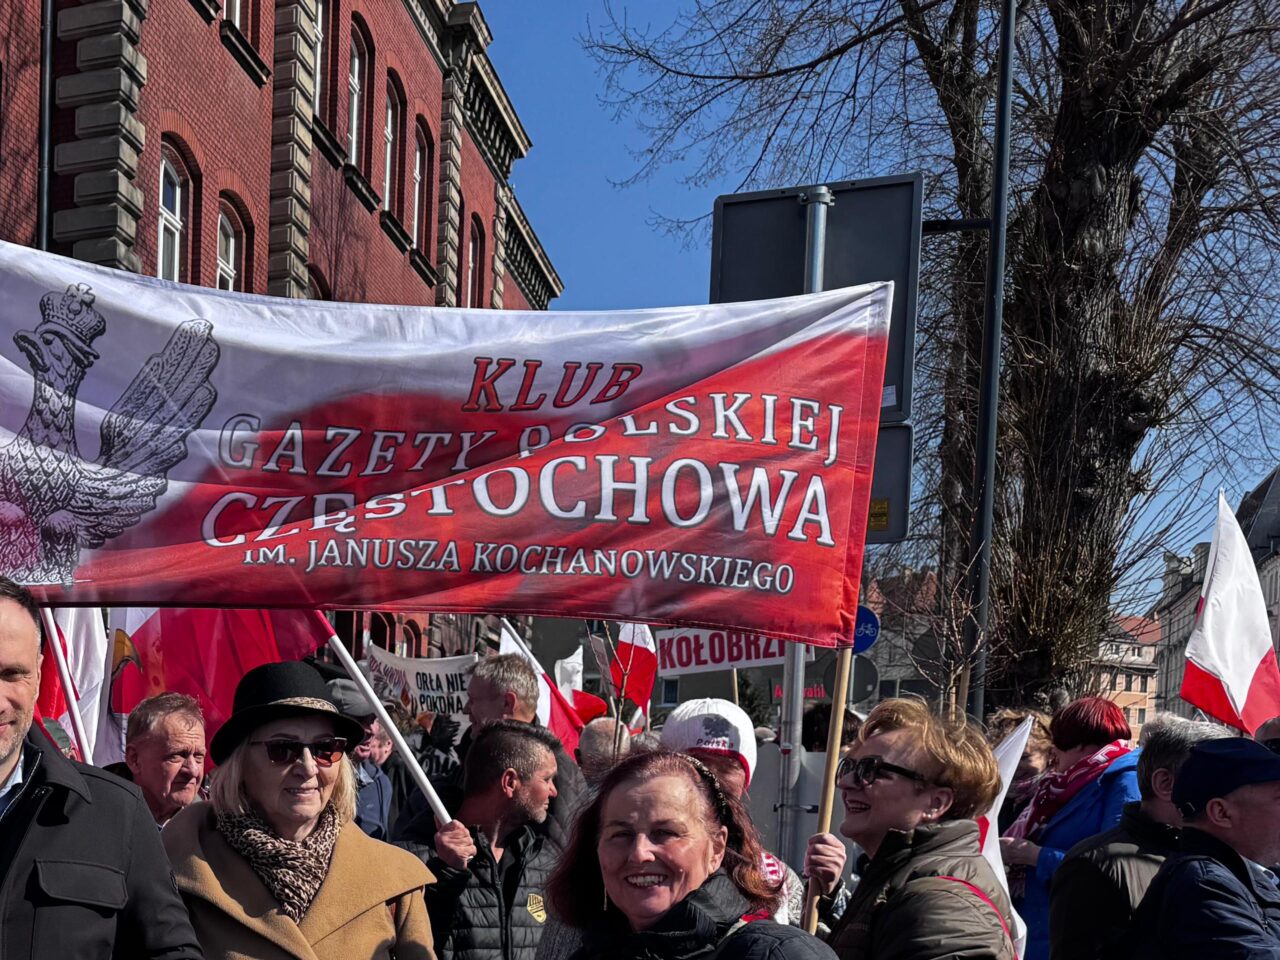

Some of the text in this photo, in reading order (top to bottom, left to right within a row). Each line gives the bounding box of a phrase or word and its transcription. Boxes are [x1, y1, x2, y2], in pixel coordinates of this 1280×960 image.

[462, 355, 643, 413] KLUB
[218, 392, 843, 479] GAZETY POLSKIEJ
[202, 453, 836, 547] CZĘSTOCHOWA
[243, 538, 795, 595] IM. JANUSZA KOCHANOWSKIEGO
